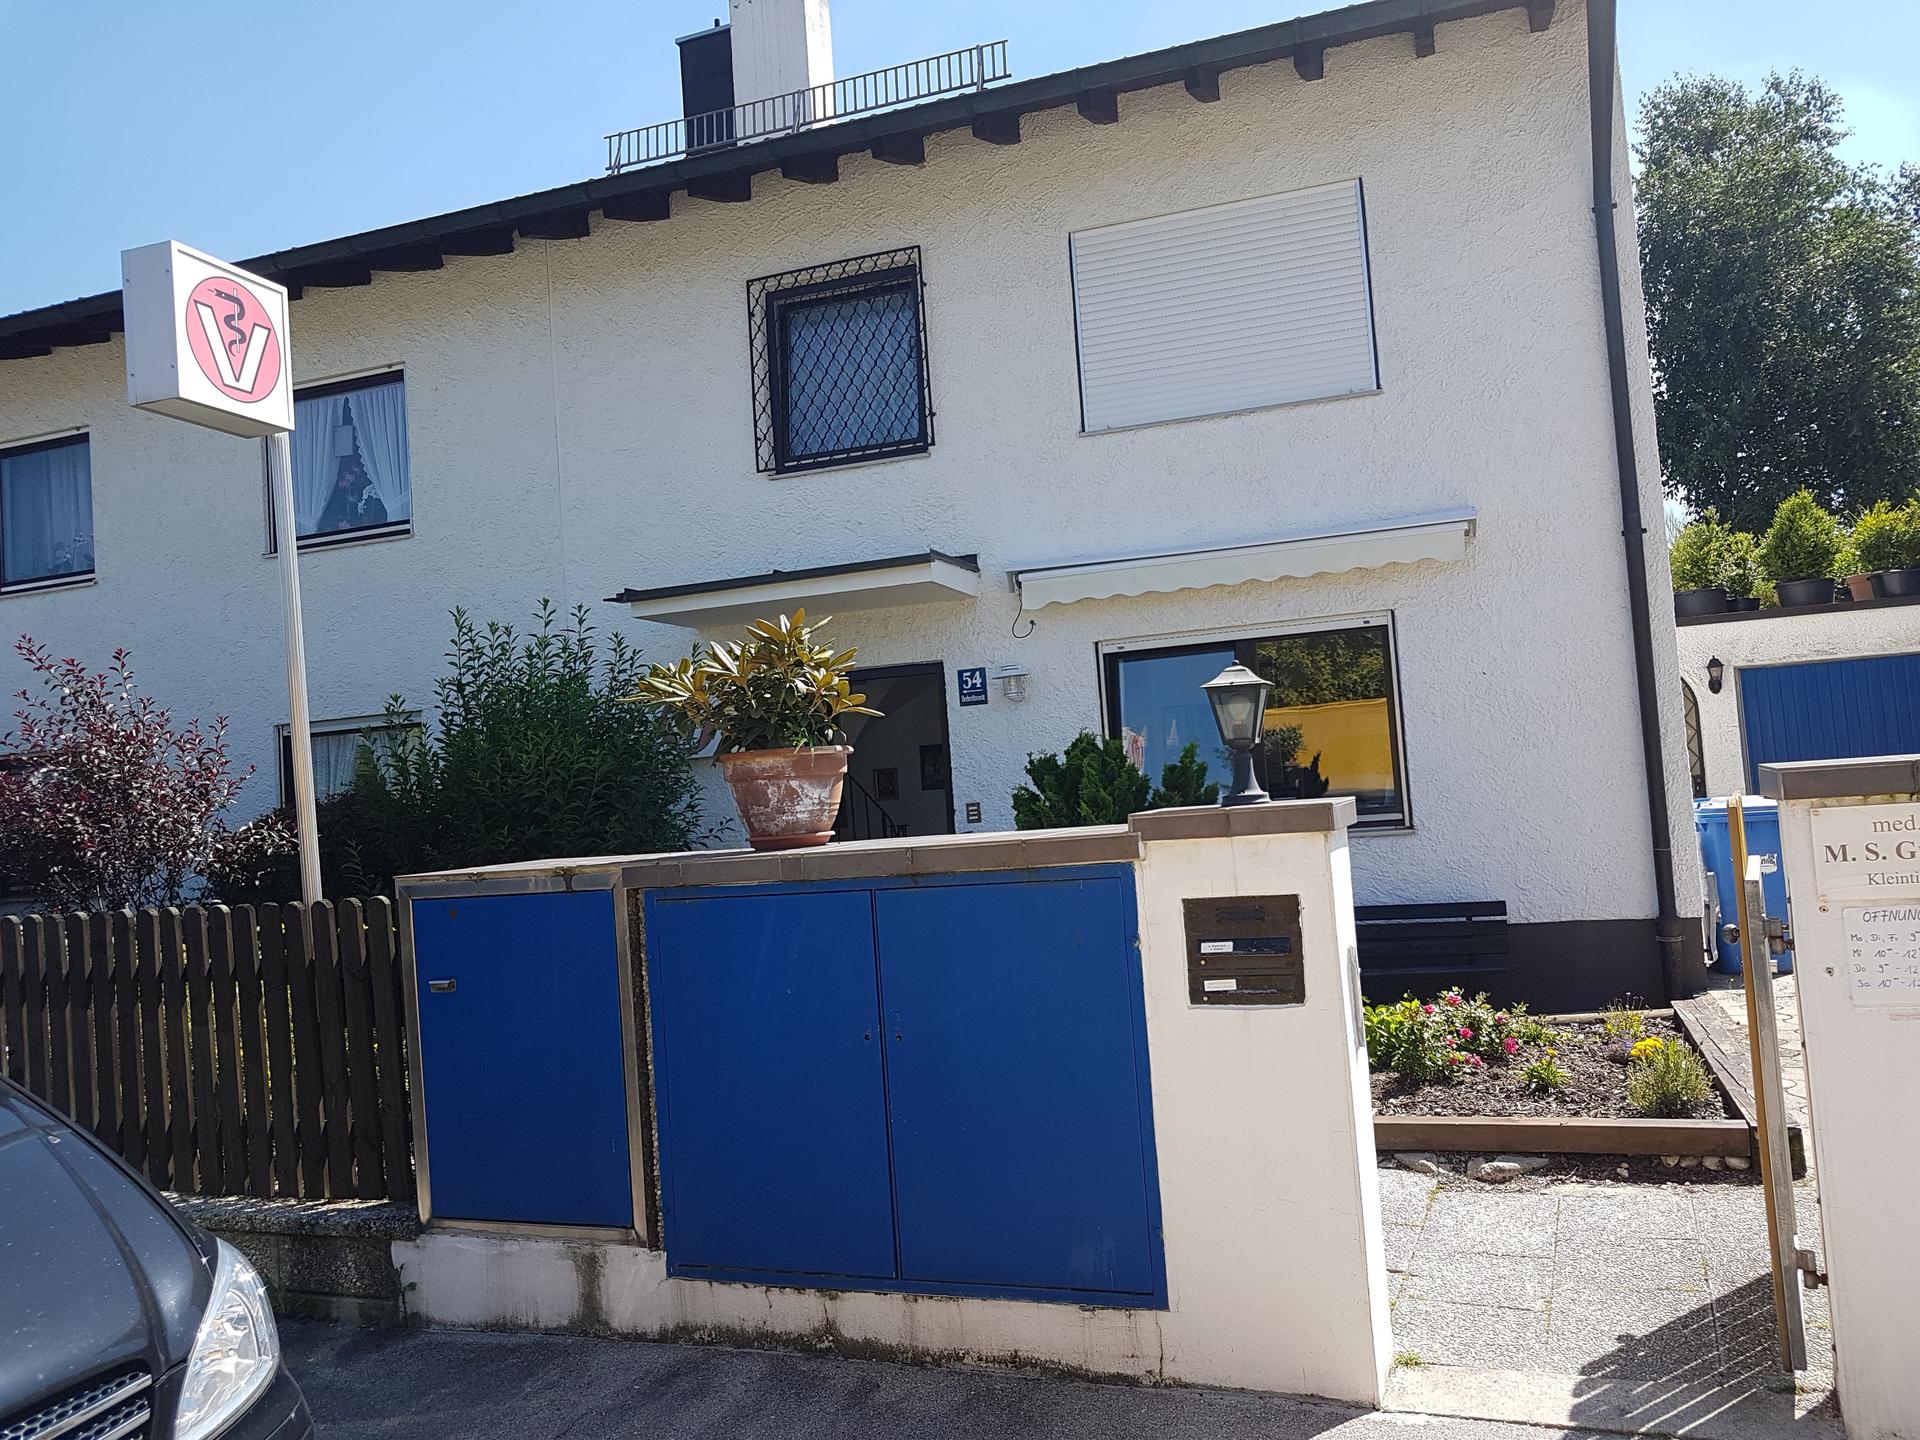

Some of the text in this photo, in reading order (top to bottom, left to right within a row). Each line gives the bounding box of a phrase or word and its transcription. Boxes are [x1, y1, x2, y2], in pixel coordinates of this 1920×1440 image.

[963, 671, 982, 689] 54
[1872, 814, 1920, 833] med.
[1823, 840, 1920, 863] M. S. G
[1853, 963, 1867, 973] Do
[1857, 979, 1871, 988] Sa
